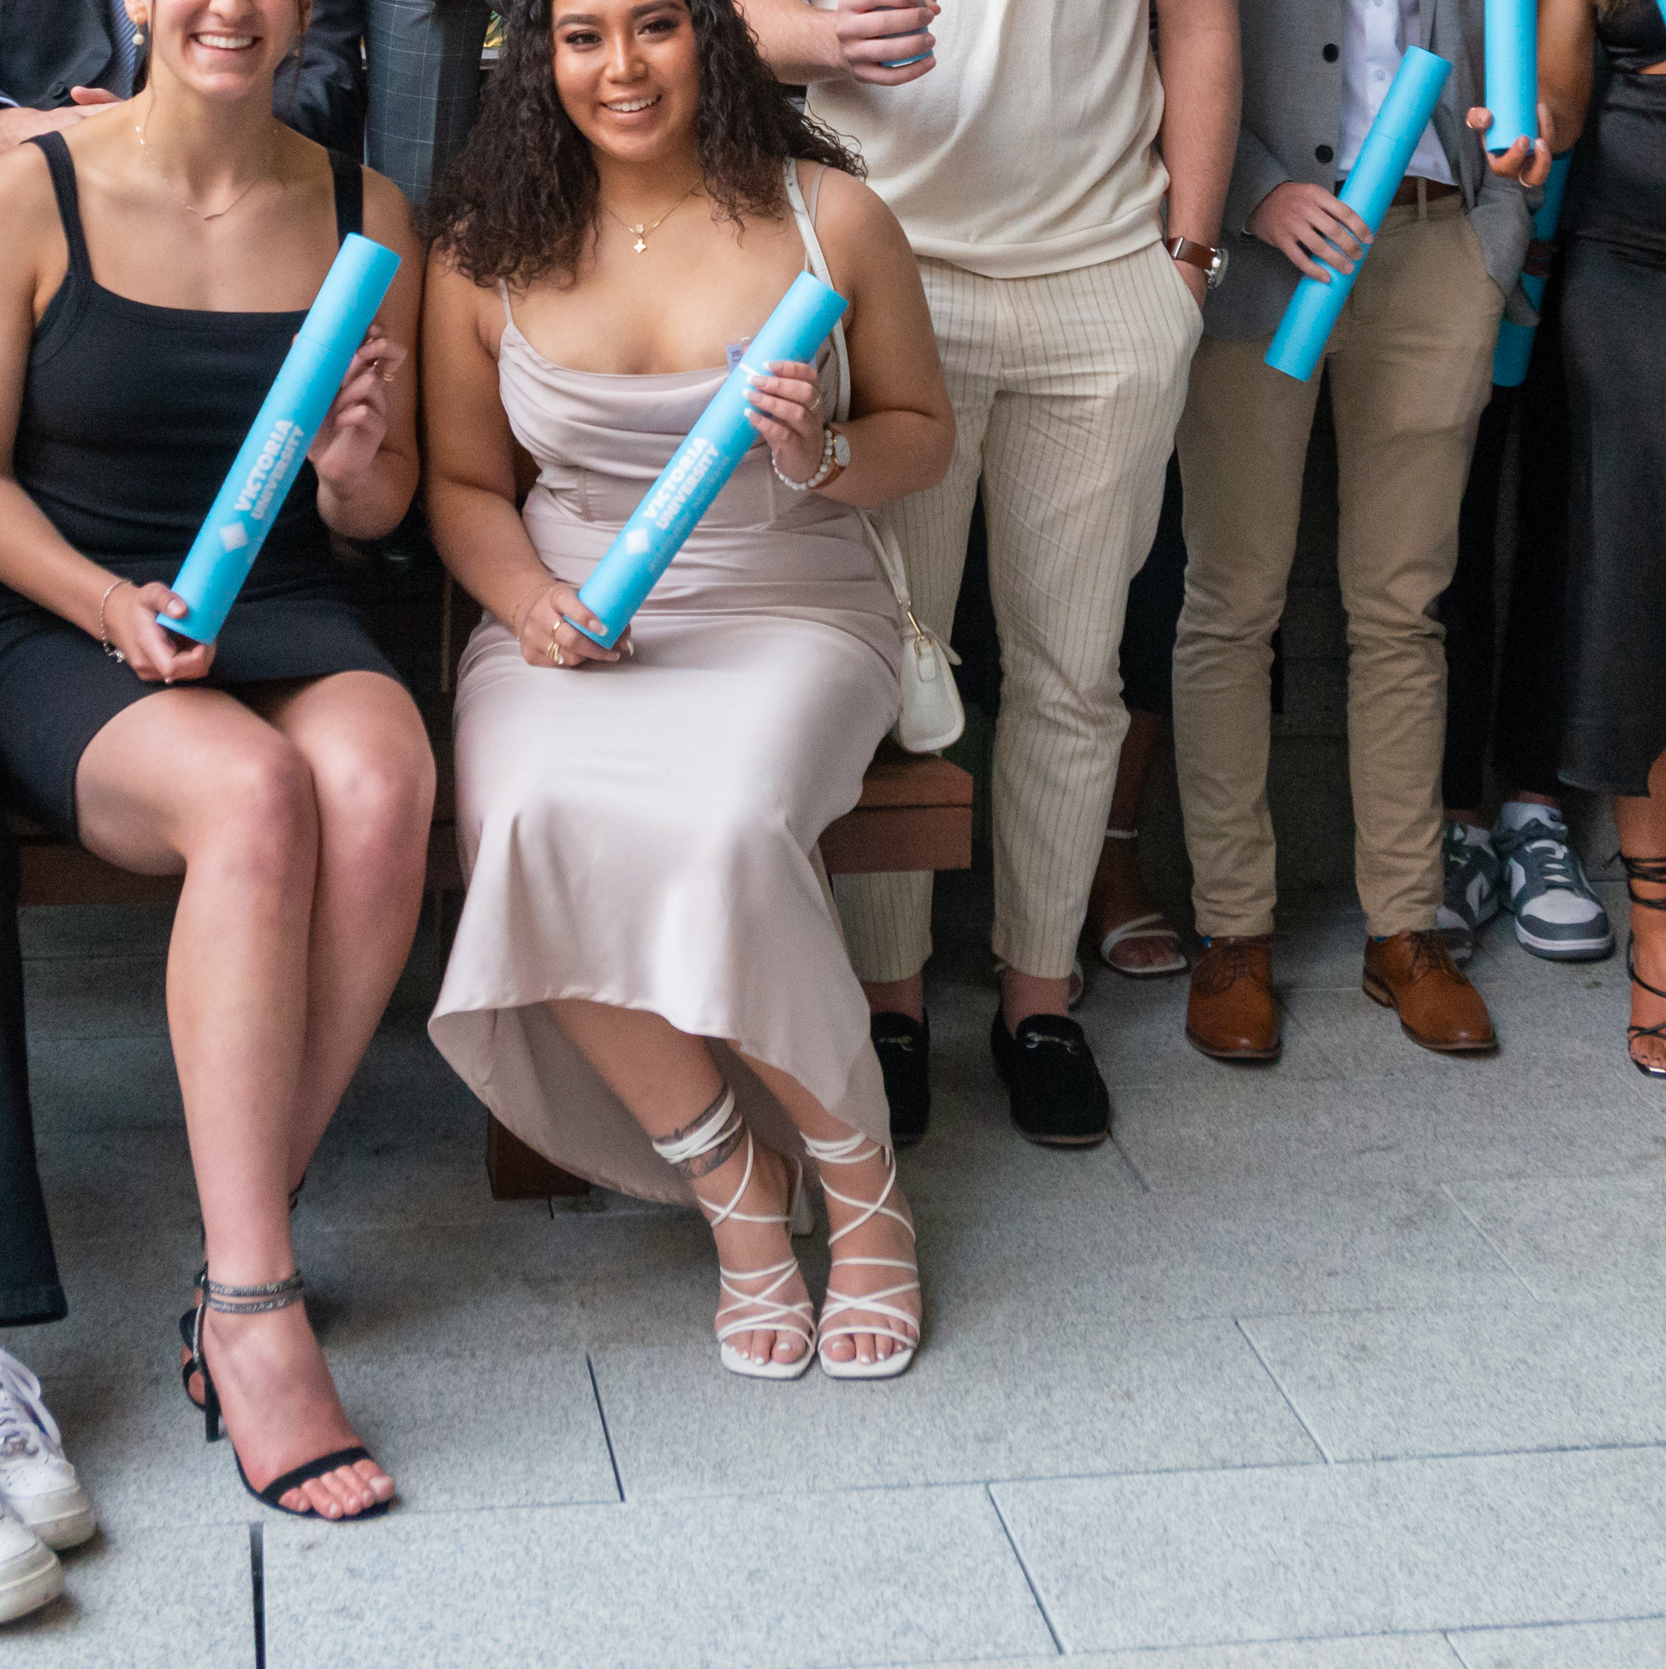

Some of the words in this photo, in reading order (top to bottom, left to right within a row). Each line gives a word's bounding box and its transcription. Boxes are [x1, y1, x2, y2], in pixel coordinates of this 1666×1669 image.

[233, 420, 293, 512] VICTORIA
[250, 424, 305, 520] UNIVERSITY
[642, 437, 709, 519] VICTORIA
[655, 443, 719, 530] UNIVERSITY
